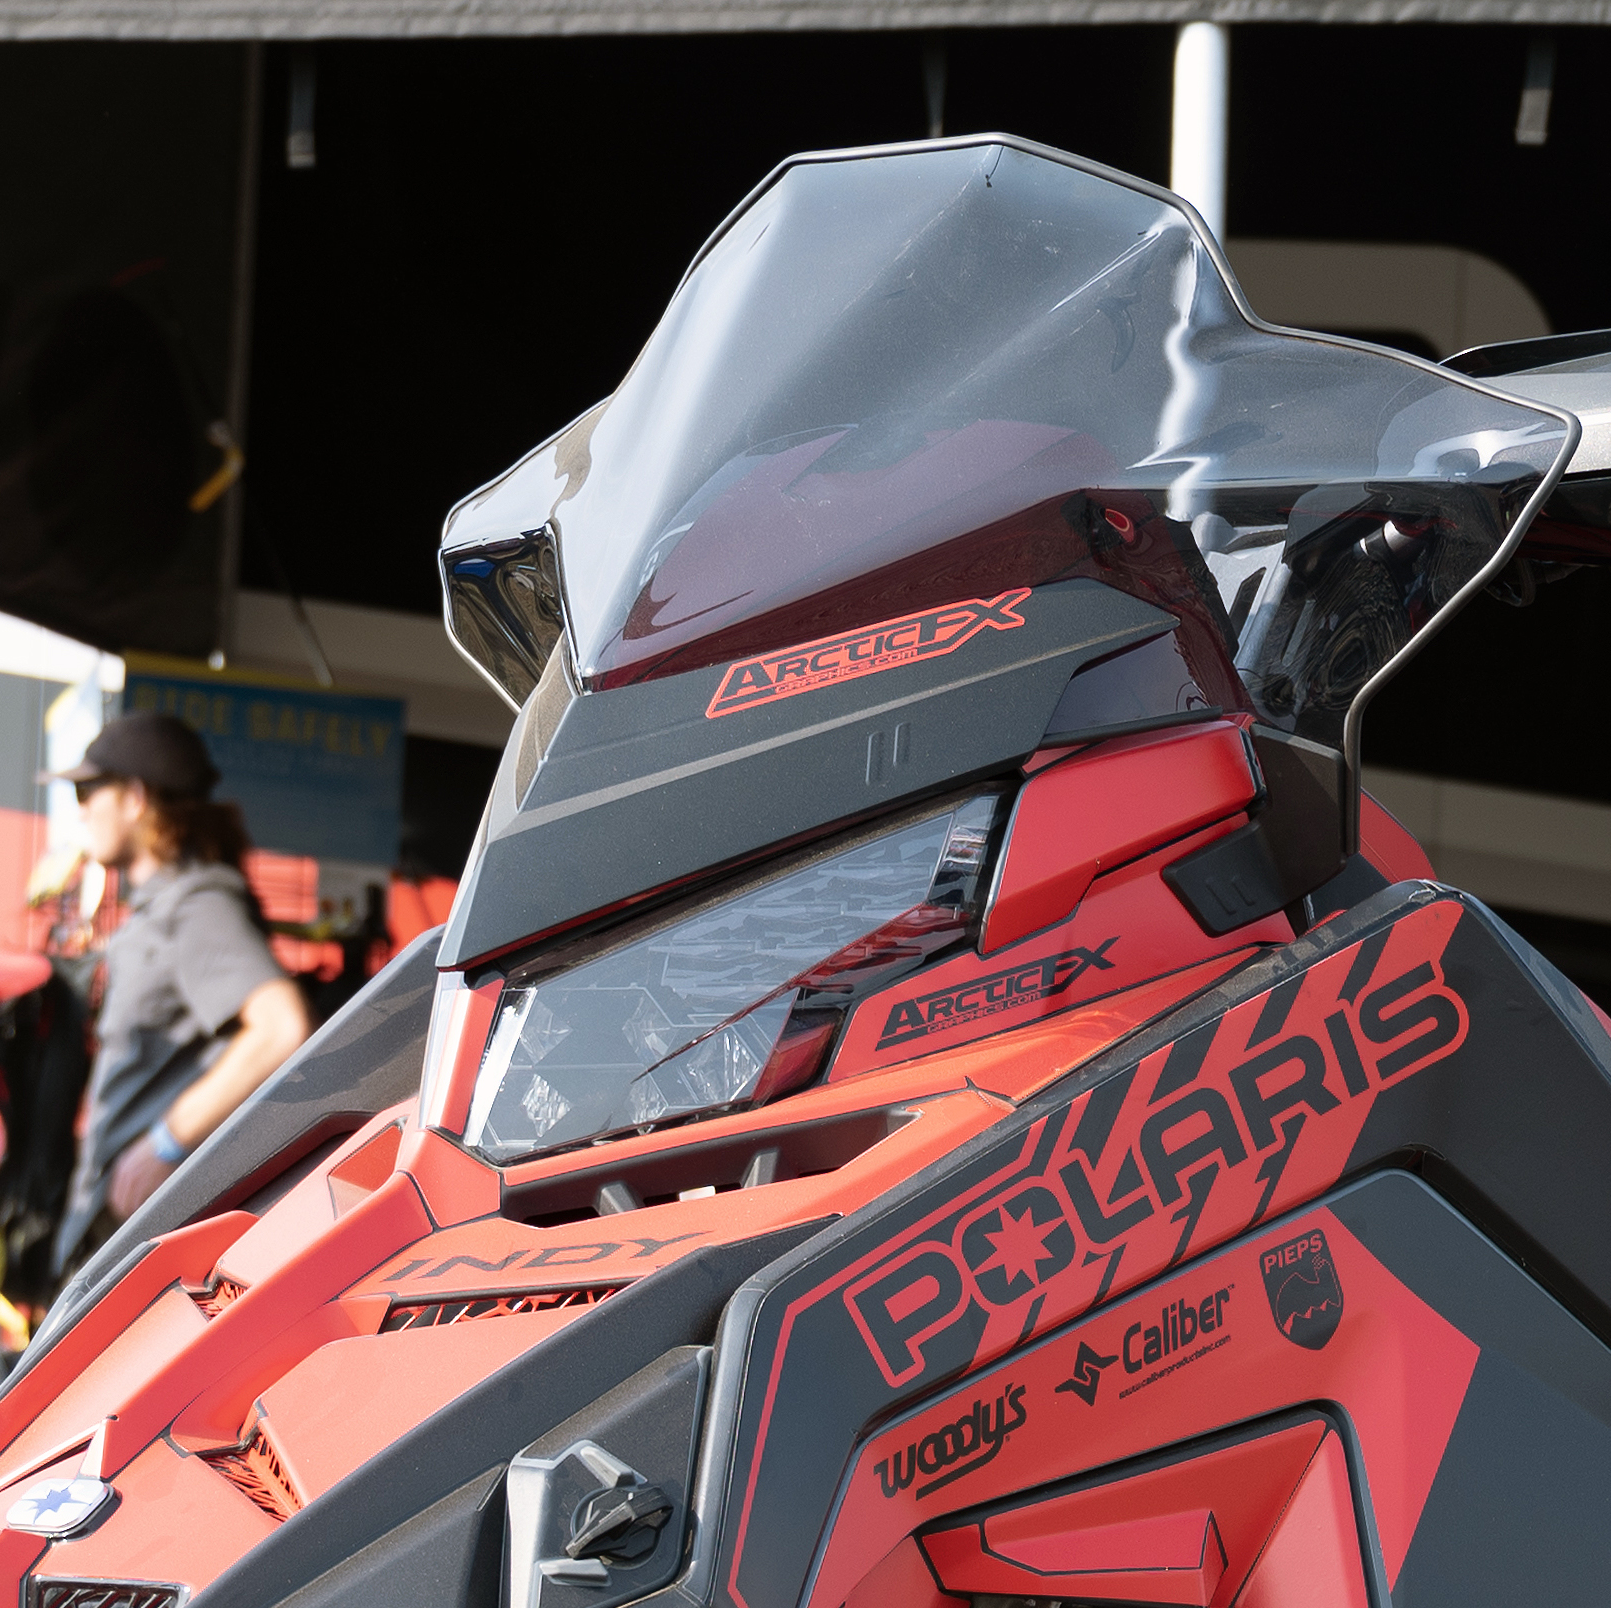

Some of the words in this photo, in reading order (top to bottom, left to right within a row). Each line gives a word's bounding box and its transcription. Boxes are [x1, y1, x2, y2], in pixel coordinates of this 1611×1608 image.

[847, 955, 1467, 1386] POLARIS
[379, 1230, 715, 1283] INDY
[1263, 1233, 1324, 1275] PIEPS
[1121, 1287, 1232, 1375] Caliber
